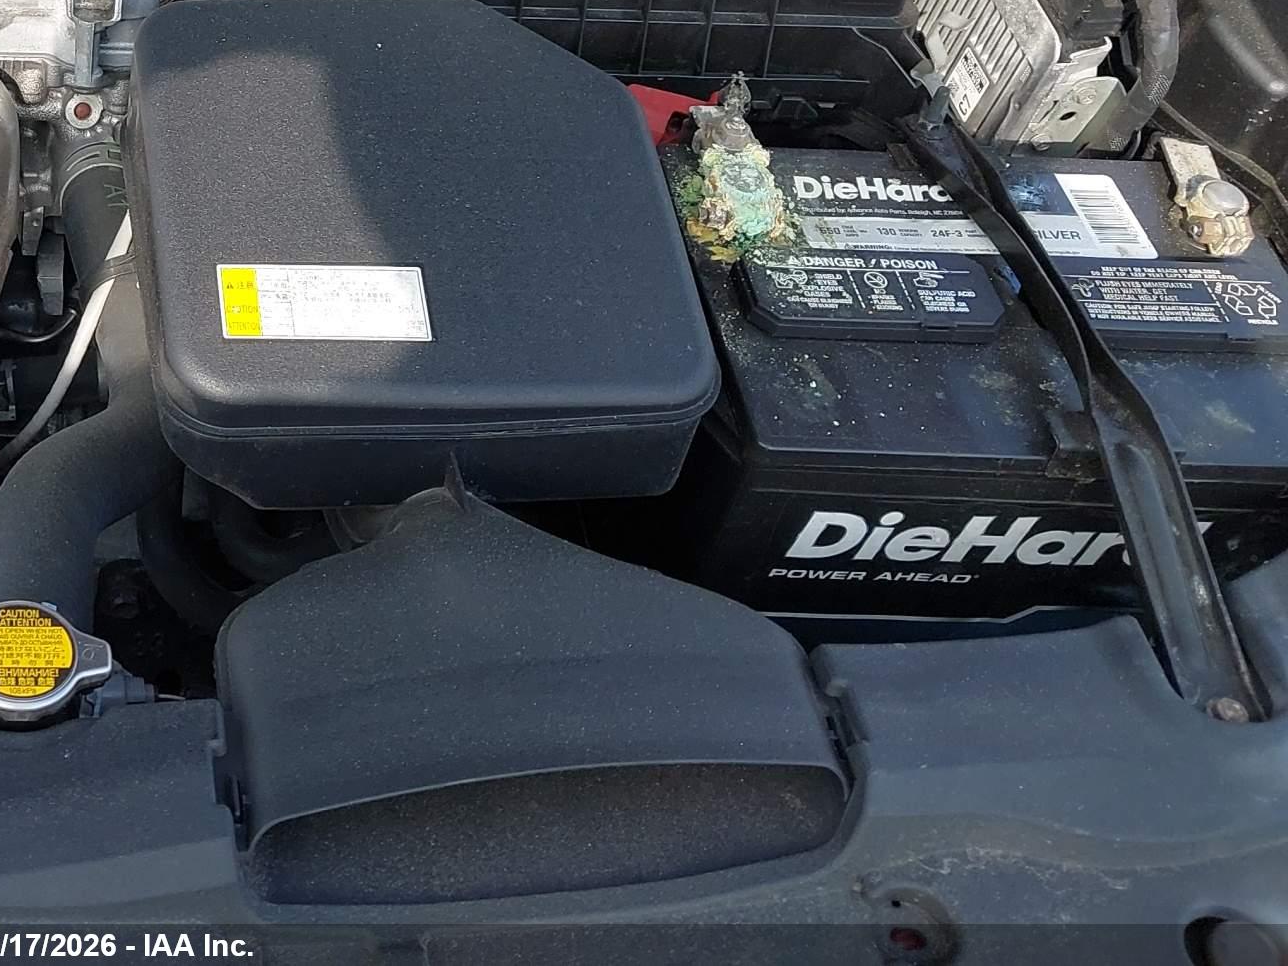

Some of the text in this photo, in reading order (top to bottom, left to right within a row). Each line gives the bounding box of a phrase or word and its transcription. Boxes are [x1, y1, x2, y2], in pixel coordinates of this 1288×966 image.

[802, 206, 836, 214] Distributed
[877, 228, 896, 236] 130
[931, 230, 963, 238] 24F-3
[1035, 230, 1081, 240] ILVER
[803, 256, 866, 268] DANGER
[880, 258, 938, 270] POISON
[1142, 281, 1193, 289] IMMEDIATELY
[1103, 293, 1143, 301] MEDICAL
[226, 305, 258, 314] CAUTION
[228, 321, 261, 331] ATTENTION
[785, 511, 1213, 567] DieHar
[768, 568, 867, 582] POWER
[0, 618, 53, 627] ATTENTION
